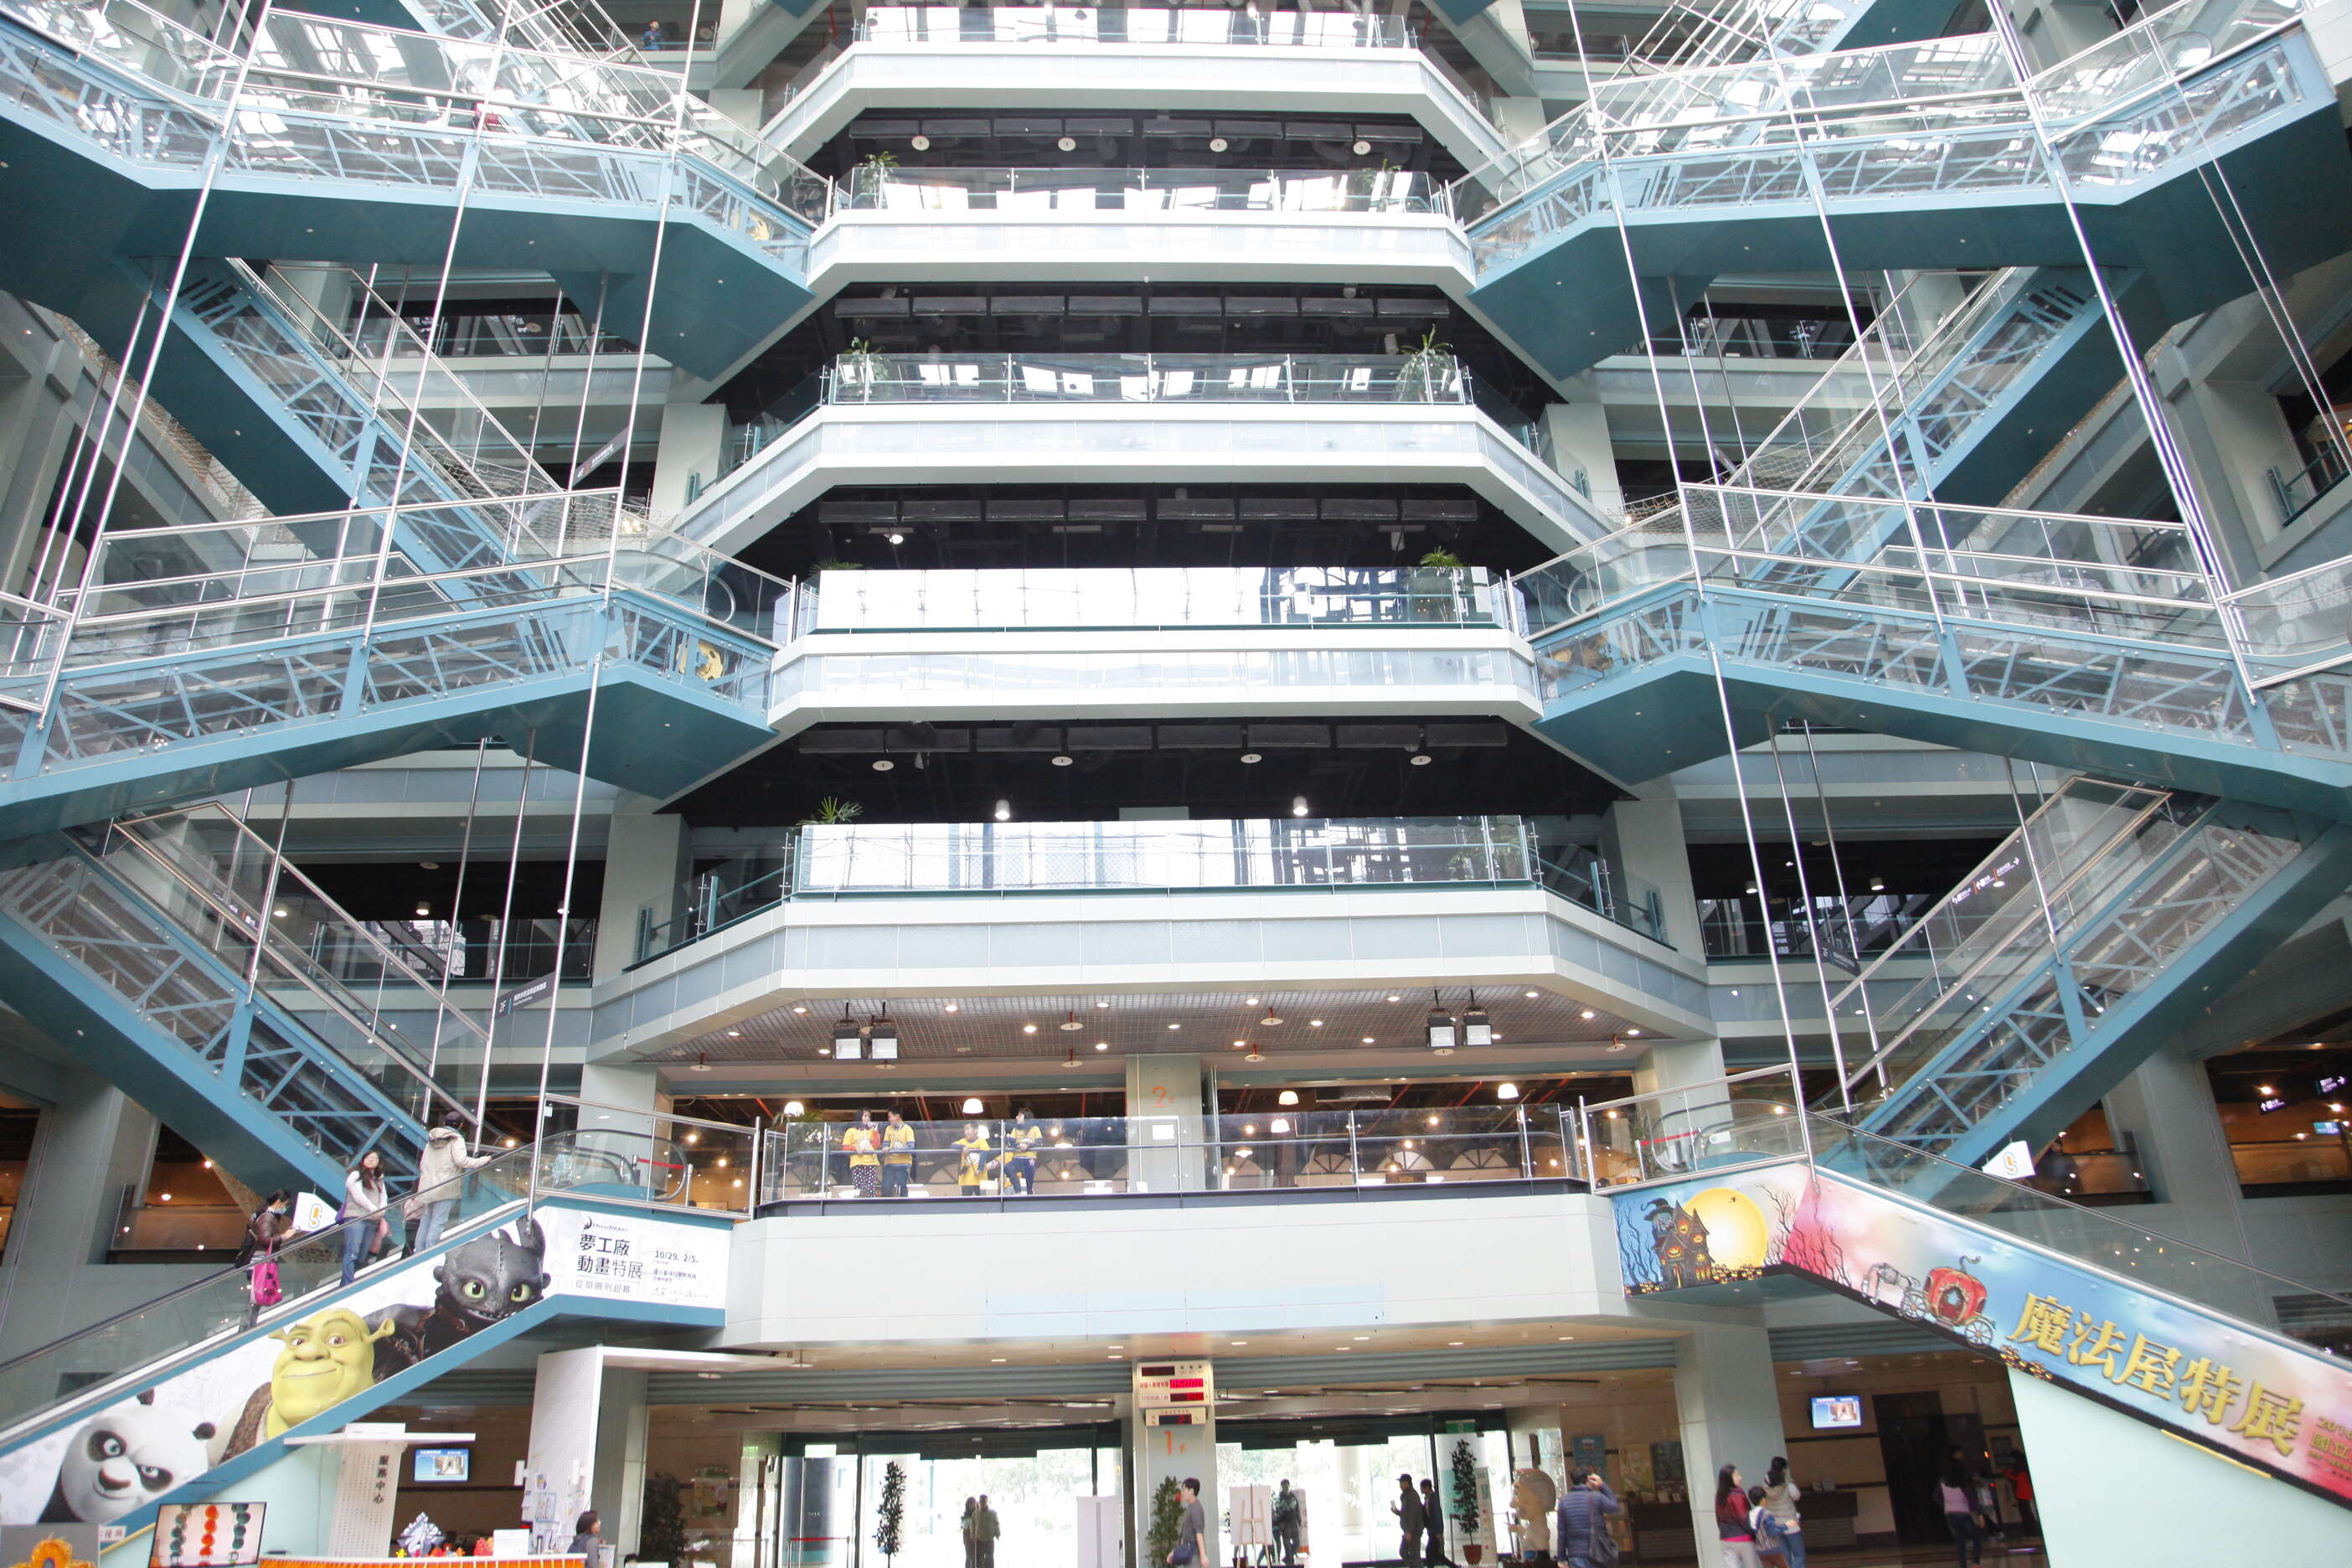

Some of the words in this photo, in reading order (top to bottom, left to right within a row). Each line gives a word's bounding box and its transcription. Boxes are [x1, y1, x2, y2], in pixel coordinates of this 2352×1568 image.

[580, 1234, 630, 1256] 夢工廠
[577, 1255, 643, 1279] 動畫特展
[2006, 1292, 2305, 1457] 魔法屋特展
